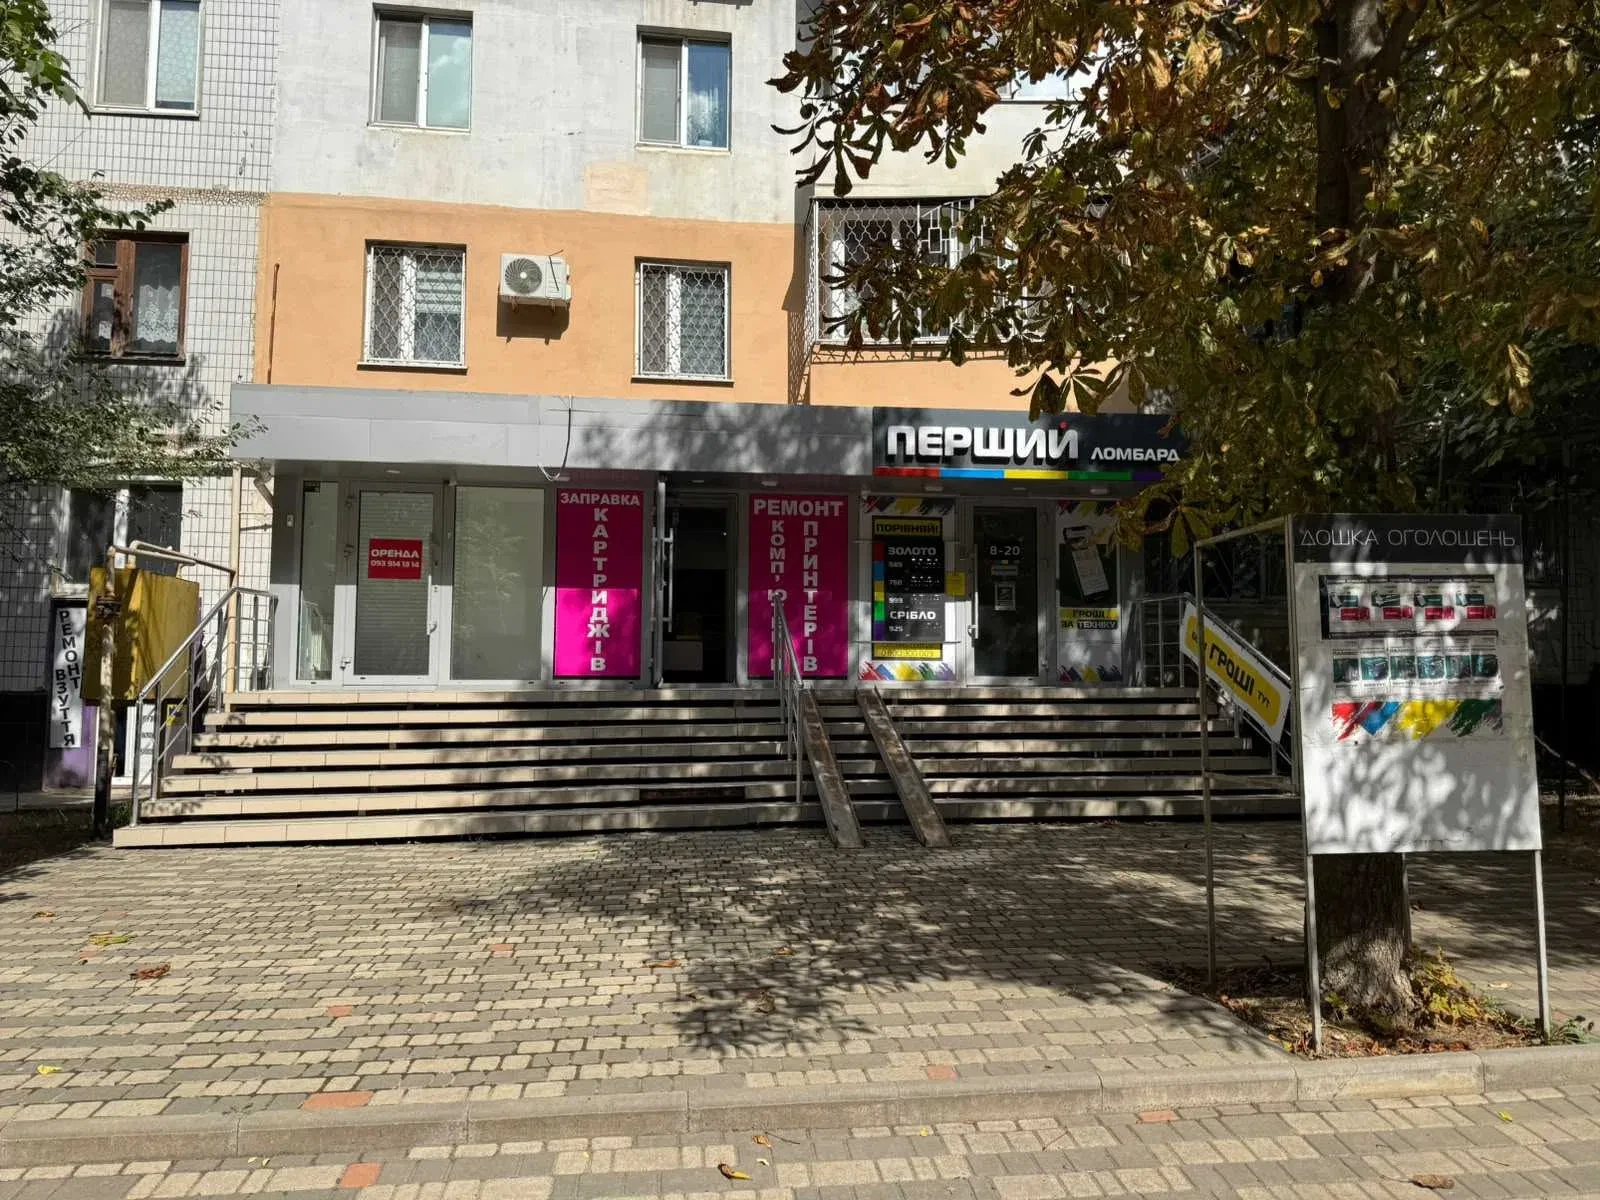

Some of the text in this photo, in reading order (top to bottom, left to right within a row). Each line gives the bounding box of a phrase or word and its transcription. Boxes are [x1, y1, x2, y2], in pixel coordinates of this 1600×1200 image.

[887, 421, 1181, 462] ПЕРШИЙ ЛОМБАРД
[560, 492, 641, 506] ЗАПРАВКА
[753, 499, 843, 517] РЕМОНТ
[1301, 529, 1516, 547] ДОШКА ОГОЛОШЕНЬ
[371, 549, 420, 559] ОРЕНДА
[887, 546, 937, 556] ЗОЛОТО
[990, 545, 1021, 556] 8-20
[587, 508, 610, 672] КАРТРИДЖІВ
[803, 521, 819, 672] ПРИНТЕРІВ
[889, 610, 937, 620] СРІБЛО
[59, 610, 81, 689] РЕМОНТ
[1209, 643, 1255, 696] ГРОШІ
[55, 669, 75, 746] ВЗУТТЯ
